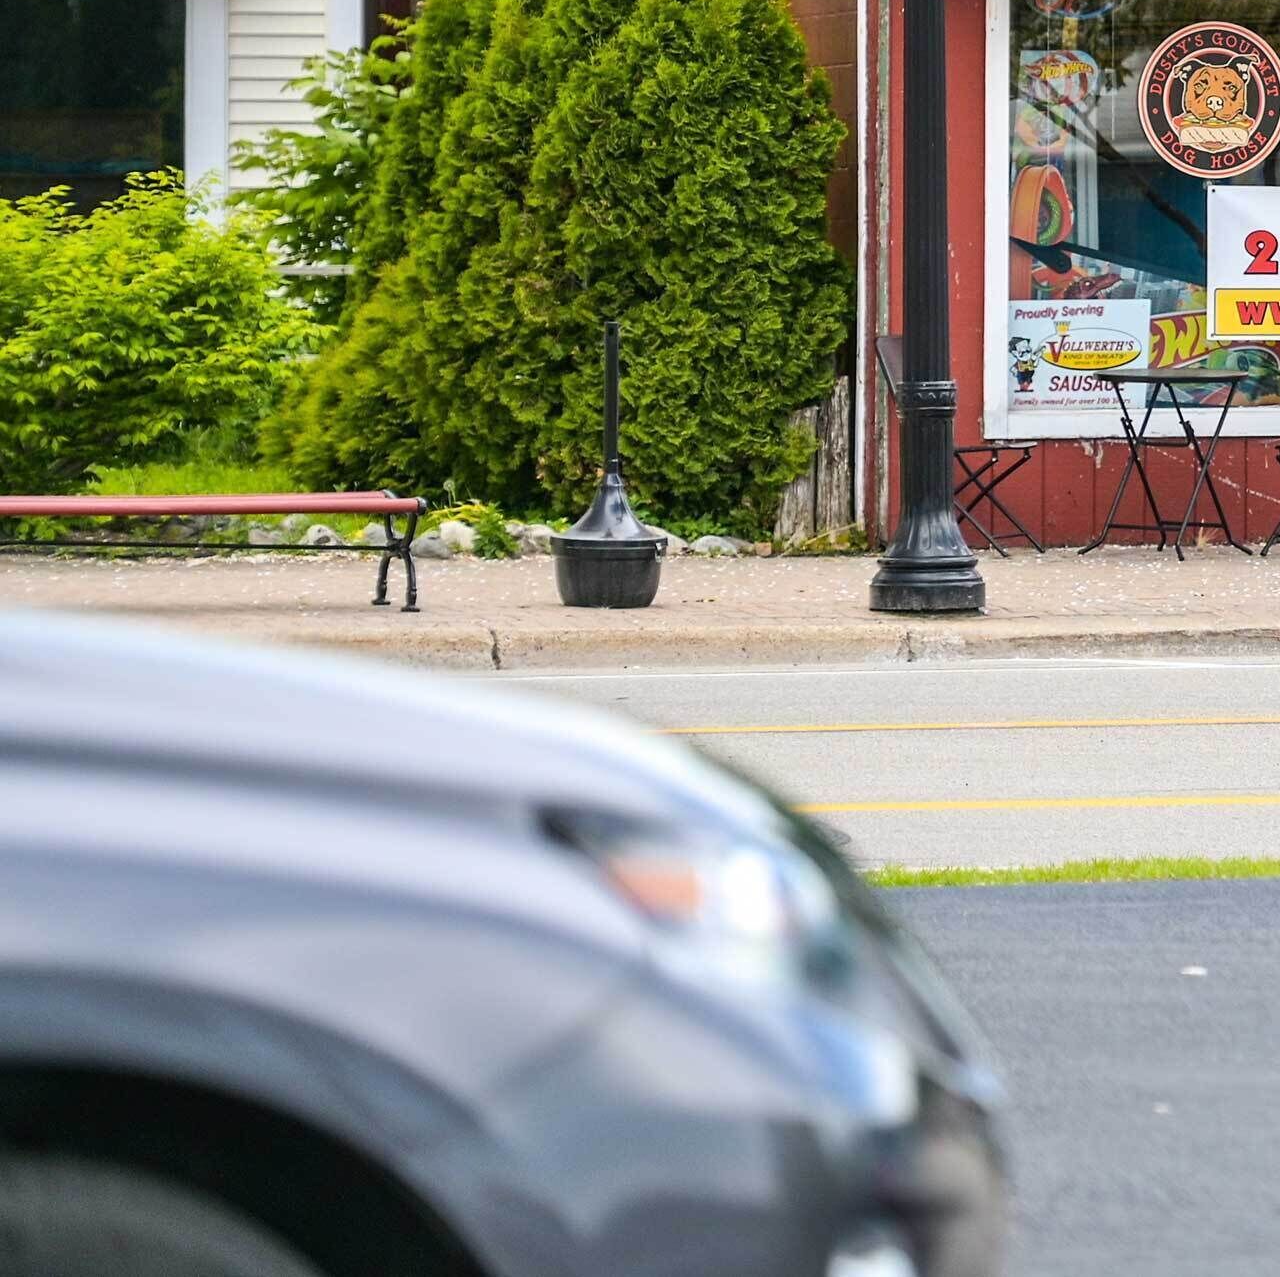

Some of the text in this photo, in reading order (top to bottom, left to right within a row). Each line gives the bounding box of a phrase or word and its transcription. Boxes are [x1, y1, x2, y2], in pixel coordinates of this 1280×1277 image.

[1150, 33, 1204, 95] DUSTY'S
[1212, 32, 1279, 97] GOURMET
[1161, 131, 1268, 169] DOG HOUSE
[1014, 304, 1105, 320] Proudly Serving
[1045, 334, 1135, 364] VOLLWERTH'S
